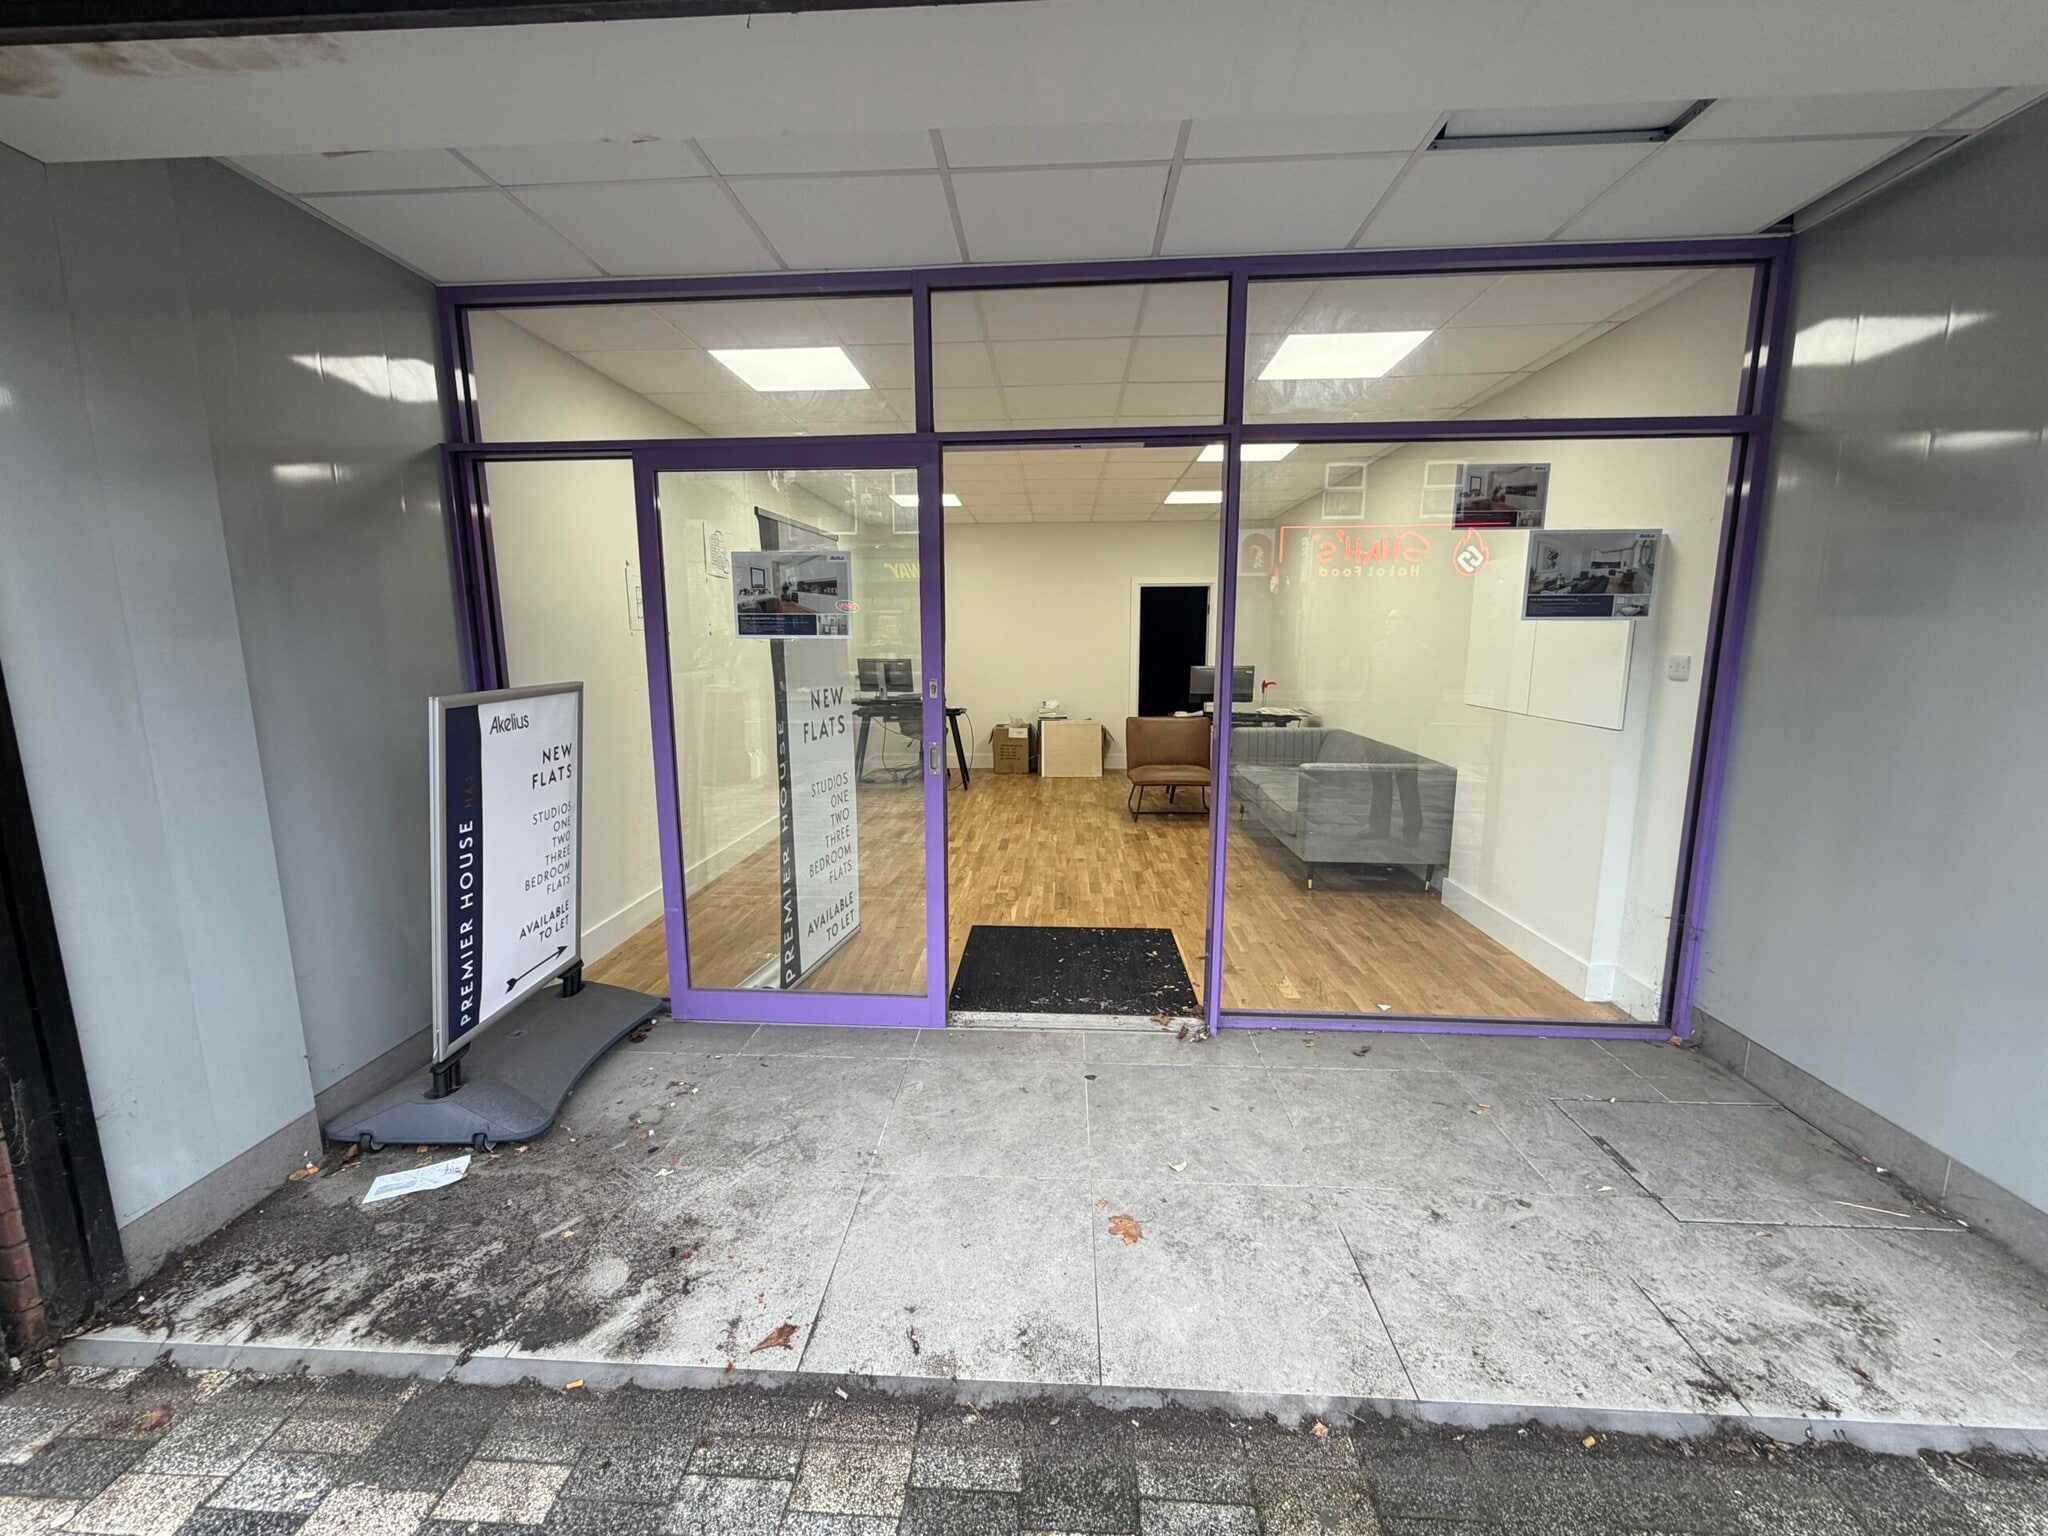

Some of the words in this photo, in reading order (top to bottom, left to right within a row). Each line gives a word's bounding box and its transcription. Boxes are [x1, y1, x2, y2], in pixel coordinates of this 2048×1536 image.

[811, 686, 844, 710] NEW
[489, 713, 530, 735] Akelius
[803, 714, 846, 744] FLATS
[542, 742, 573, 764] NEW
[532, 763, 573, 790] FLATS
[811, 771, 849, 798] STUDIOS
[830, 789, 850, 808] ONE
[532, 800, 572, 826] STUDIOS
[553, 815, 571, 832] ONE
[830, 807, 850, 827] TWO
[552, 830, 571, 848] TWO
[825, 825, 851, 848] THREE
[459, 820, 474, 910] HOUSE
[545, 844, 570, 866] THREE
[809, 842, 852, 878] BEDROOM
[525, 860, 570, 892] BEDROOM
[547, 873, 571, 895] FLATS
[829, 859, 853, 884] FLATS
[519, 900, 569, 940] AVAILABLE
[782, 847, 797, 984] PREMIER
[807, 891, 854, 938] AVAILABLE
[826, 923, 839, 942] TO
[841, 909, 855, 931] LET
[539, 926, 552, 942] TO
[555, 914, 569, 933] LET
[460, 918, 474, 1027] PREMIER
